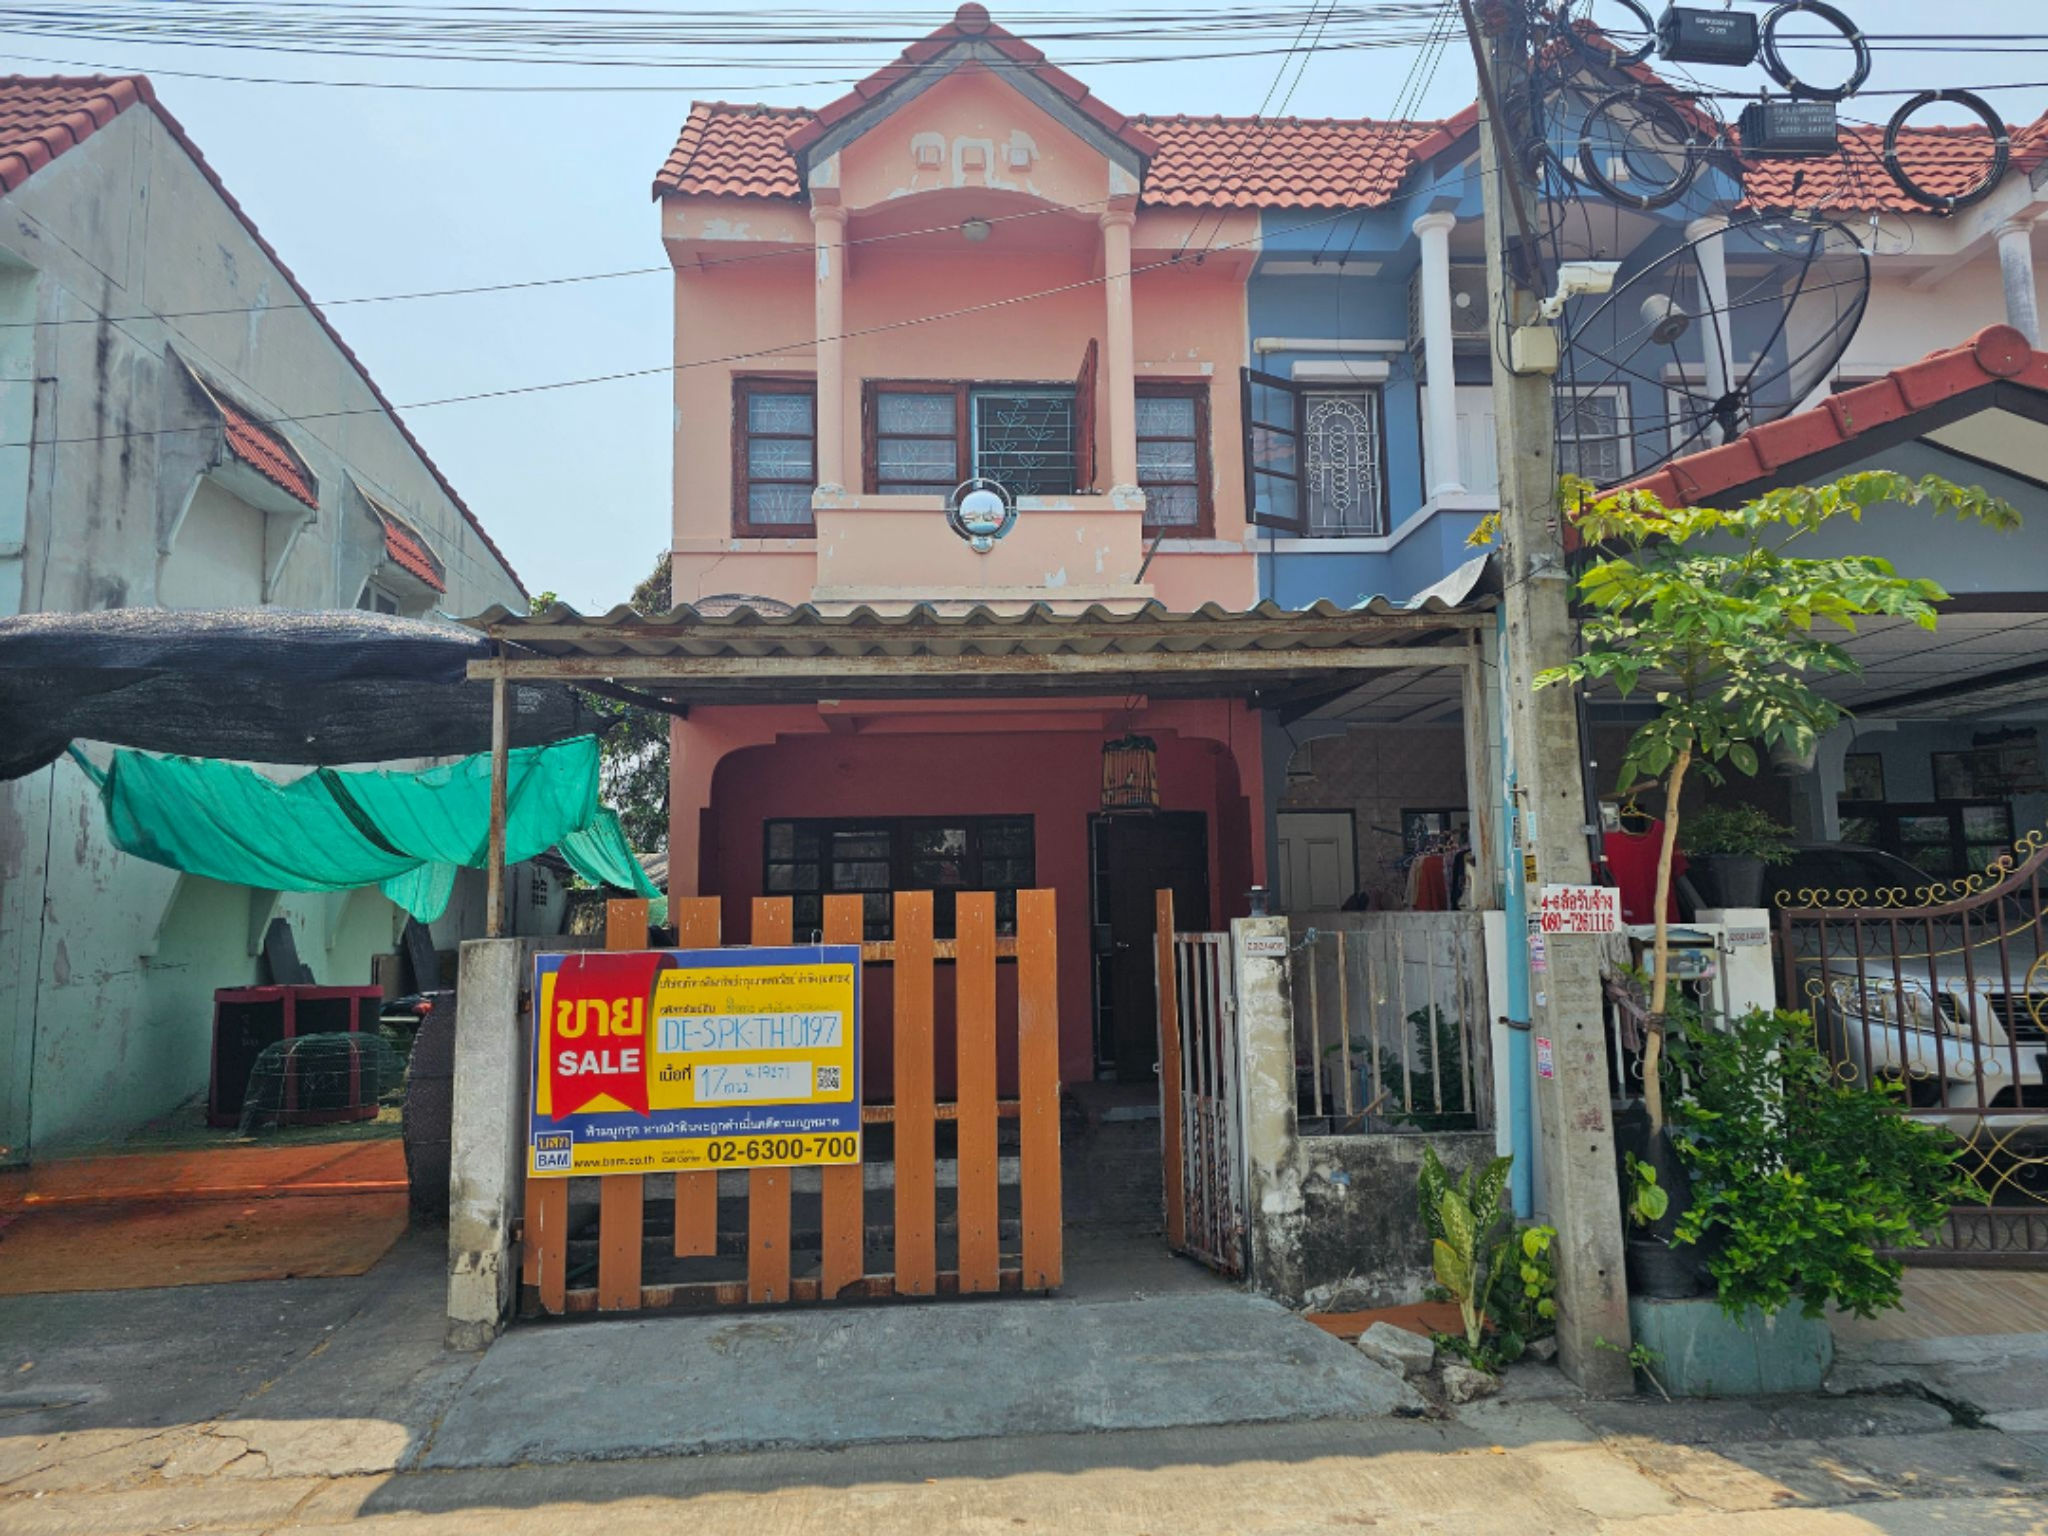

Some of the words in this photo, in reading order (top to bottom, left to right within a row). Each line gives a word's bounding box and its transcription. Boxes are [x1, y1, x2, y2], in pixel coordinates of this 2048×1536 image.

[557, 997, 643, 1038] ขาย
[557, 1048, 640, 1077] SALE
[658, 1064, 692, 1082] เนื้อที่
[585, 1123, 639, 1140] ห้ามบุกรุก
[707, 1137, 856, 1162] 02-6300-700
[538, 1152, 569, 1167] BAM
[574, 1155, 655, 1168] www.bam.co.th
